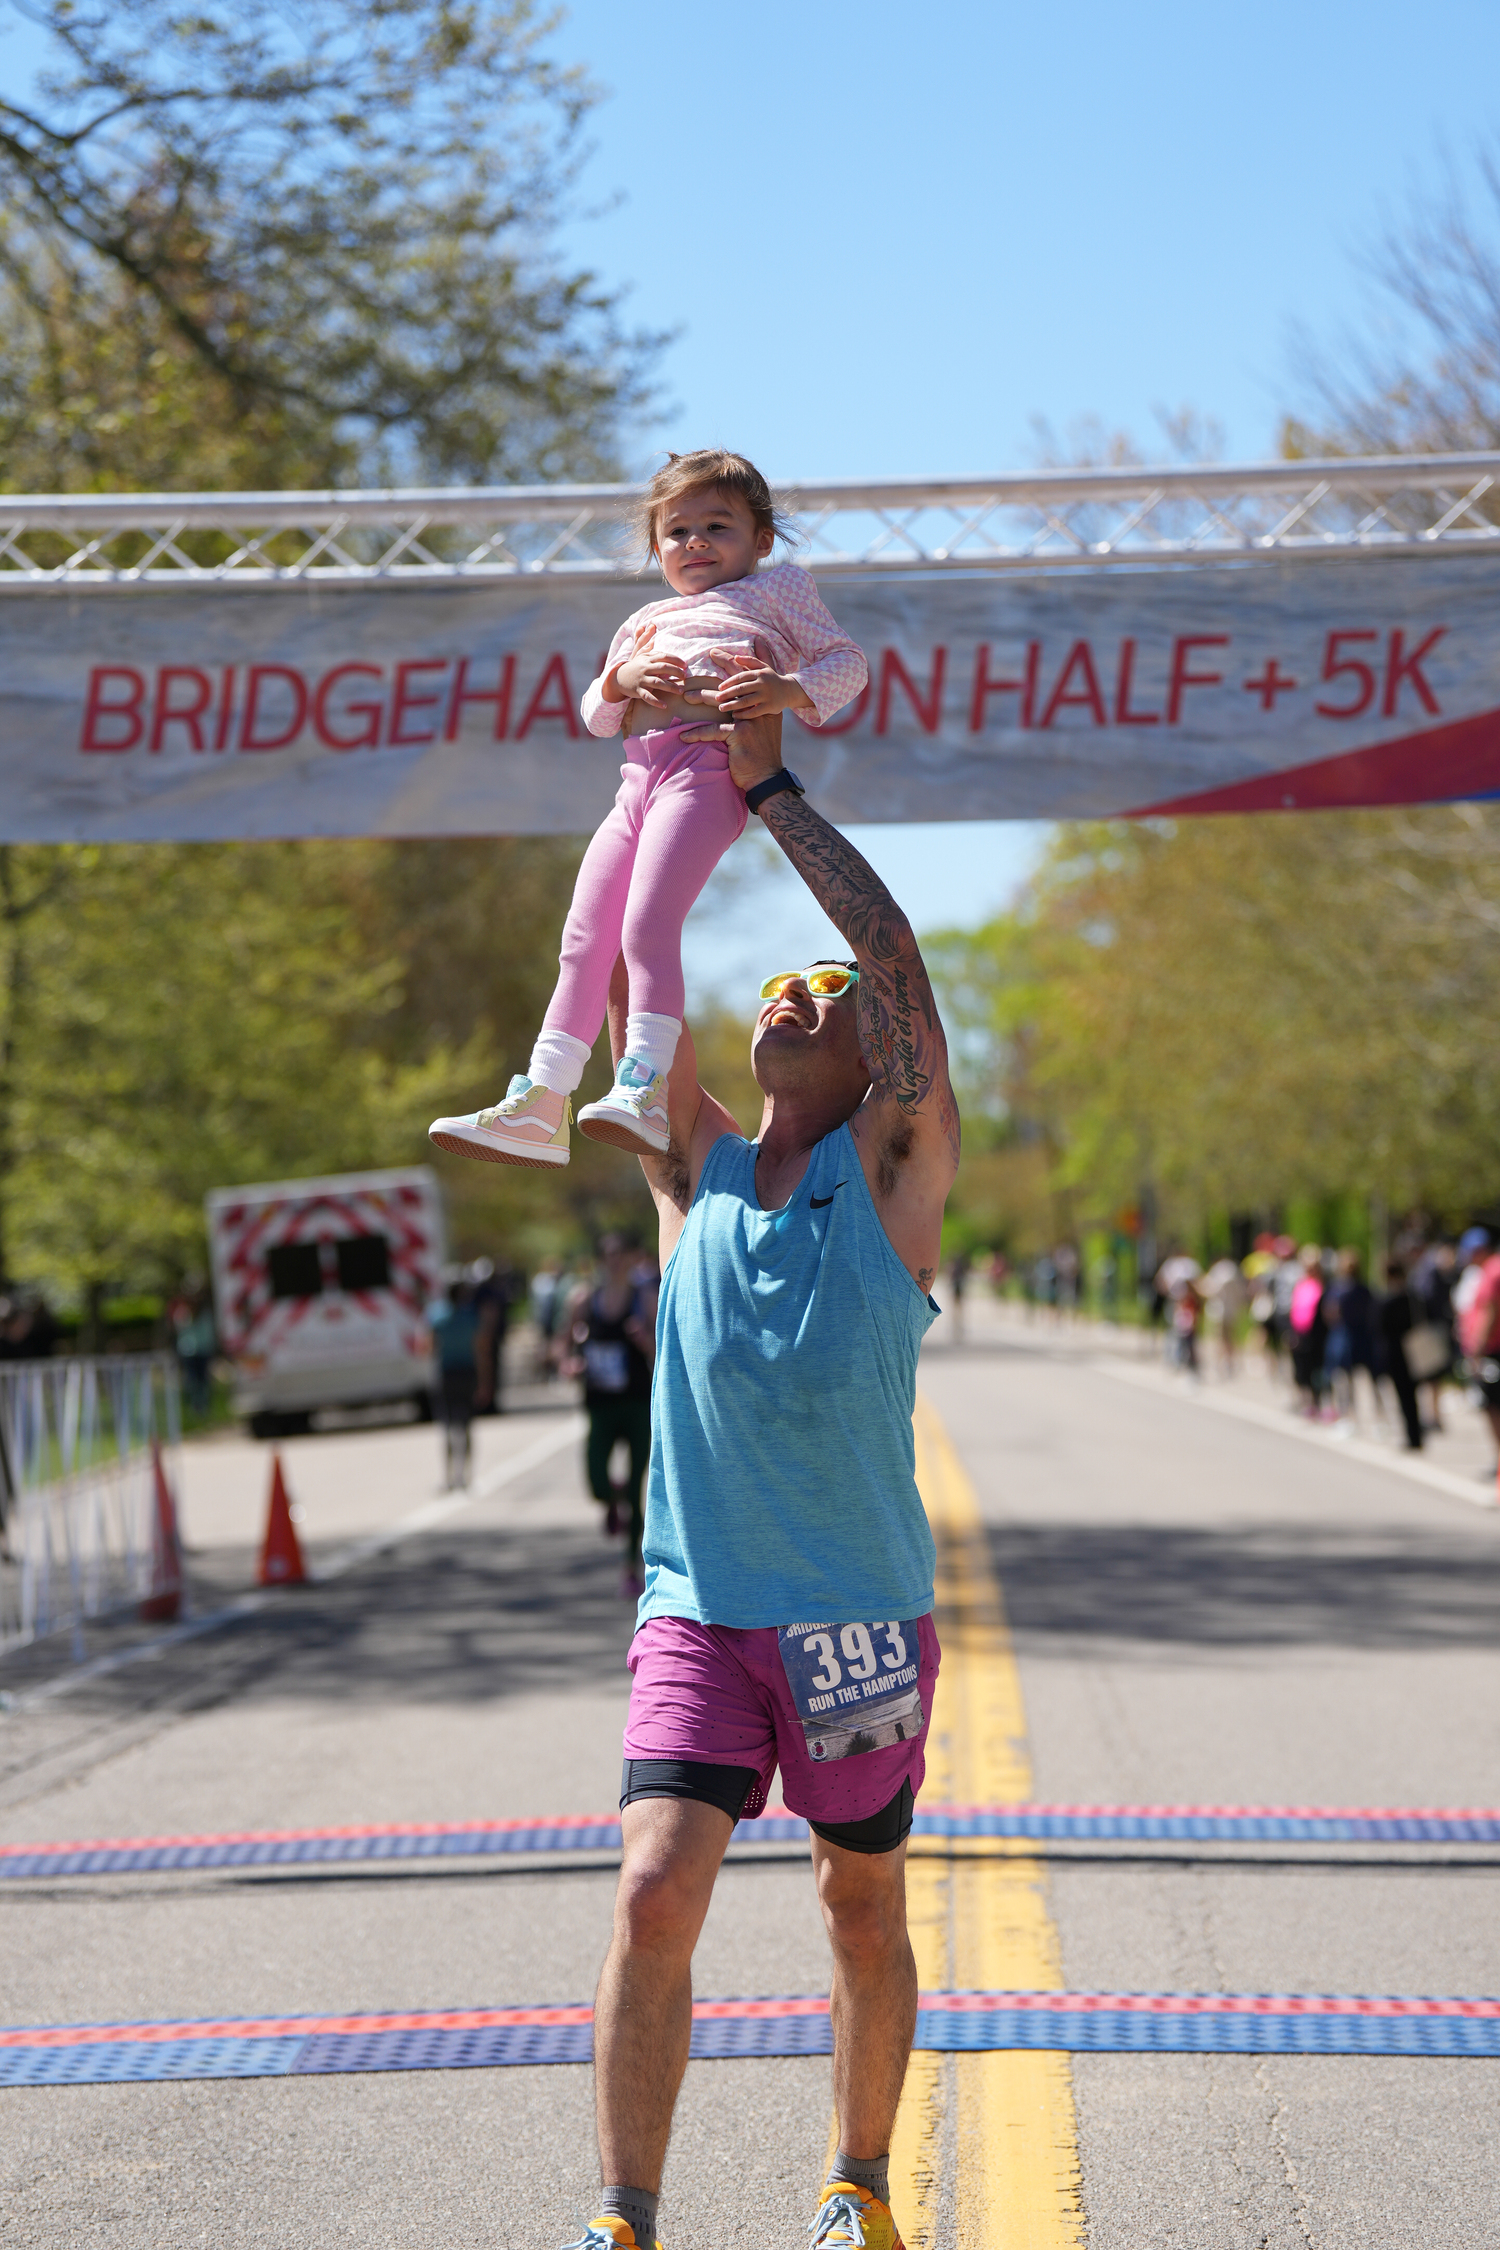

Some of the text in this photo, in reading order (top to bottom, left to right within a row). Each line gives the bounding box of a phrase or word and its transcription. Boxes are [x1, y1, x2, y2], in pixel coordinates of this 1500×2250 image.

[968, 634, 1229, 733] HALF
[1244, 659, 1296, 711] +
[1314, 626, 1450, 720] 5K
[770, 810, 815, 846] Make
[805, 842, 832, 857] the
[818, 856, 845, 875] days
[891, 1014, 912, 1036] et
[803, 1621, 907, 1691] 393
[808, 1664, 918, 1713] RUN THE HAMPTONS
